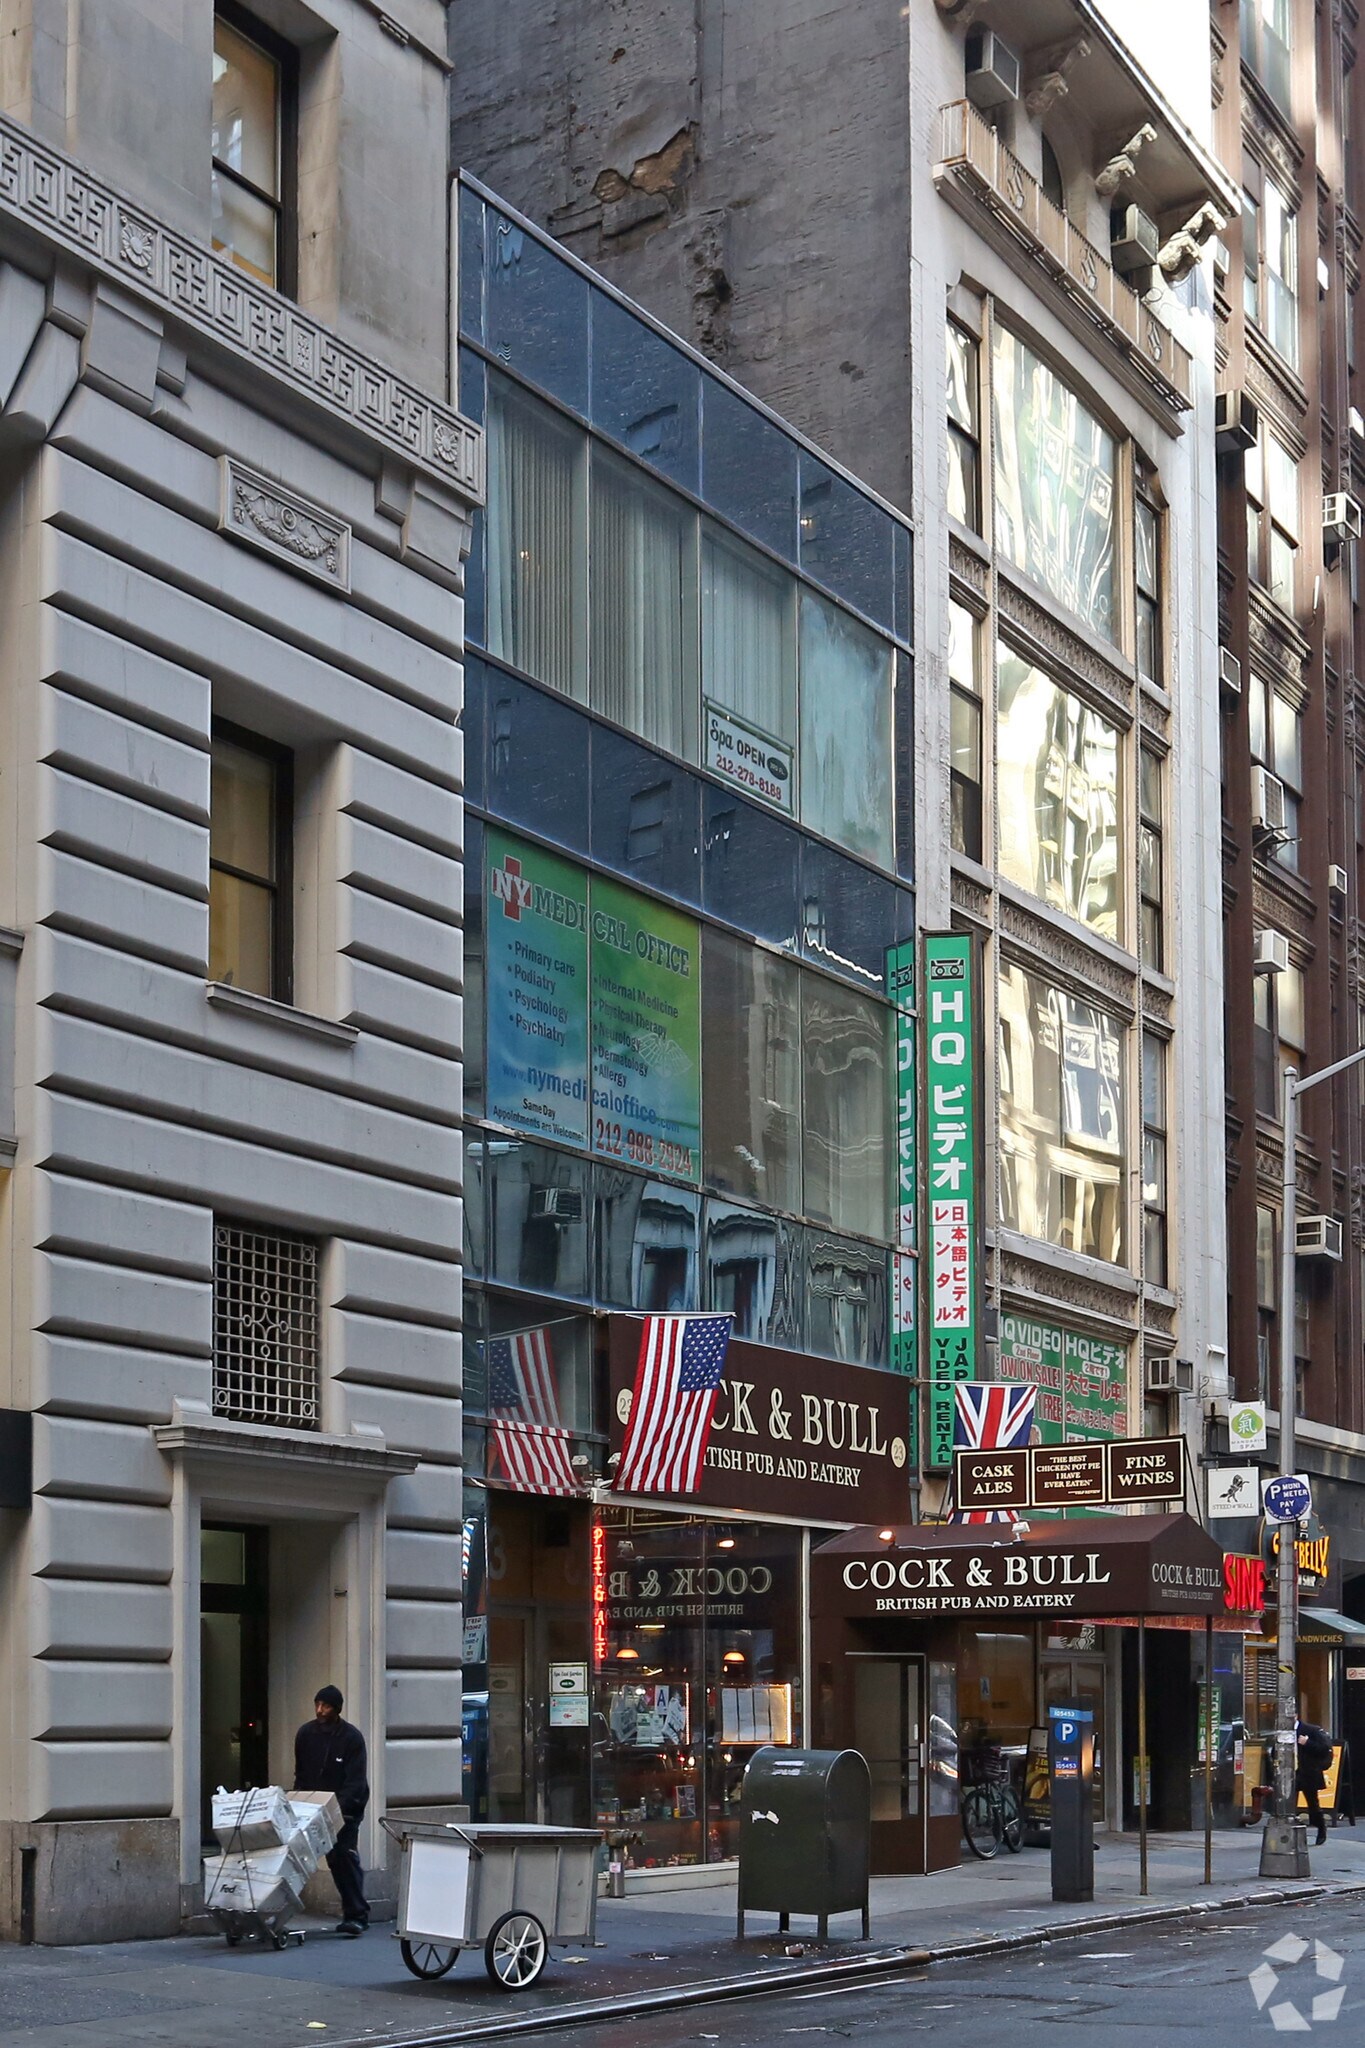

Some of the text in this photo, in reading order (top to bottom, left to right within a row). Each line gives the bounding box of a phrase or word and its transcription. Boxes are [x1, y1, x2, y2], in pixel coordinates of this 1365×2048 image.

[710, 719, 734, 750] Spa
[736, 739, 766, 769] OPEN
[716, 753, 782, 801] 212-278-8188
[493, 867, 691, 979] NY MEDICAL OFFICE
[515, 941, 576, 977] Primary care
[514, 964, 556, 995] Podiatry
[515, 988, 568, 1024] Psychology
[599, 974, 679, 1018] Internal Medicine
[516, 1013, 566, 1047] Psychiatry
[599, 998, 667, 1040] Physical Therapy
[600, 1022, 640, 1053] Neurology
[599, 1045, 648, 1077] Dermatology
[599, 1064, 627, 1088] Allergy
[502, 1064, 680, 1134] www.nymedicaloffice.com
[932, 990, 967, 1190] HQ ビデオ
[493, 1105, 540, 1128] Appointments
[541, 1121, 551, 1131] are
[523, 1098, 556, 1121] Same Day
[596, 1118, 692, 1176] 212-988-2924
[935, 1206, 952, 1321] レンタル
[951, 1205, 967, 1321] 日本語ビデオ
[1017, 1321, 1061, 1353] VIDEO
[1000, 1354, 1018, 1379] OW
[1019, 1358, 1033, 1381] ON
[935, 1337, 951, 1464] VIDEO RENTAL
[768, 1387, 793, 1442] &
[801, 1393, 888, 1456] BULL
[746, 1452, 774, 1476] PUB
[776, 1457, 807, 1480] AND
[810, 1461, 861, 1488] EATERY
[971, 1464, 1014, 1478] CASK
[1036, 1464, 1070, 1472] CHICKEN
[1088, 1462, 1100, 1470] PIE
[1125, 1454, 1166, 1470] FINE
[973, 1481, 1013, 1495] ALES
[1044, 1480, 1064, 1488] EVER
[1117, 1471, 1175, 1487] WINES
[1270, 1484, 1281, 1500] P
[1283, 1489, 1308, 1498] METER
[1280, 1500, 1295, 1508] PAY
[843, 1553, 1111, 1590] COCK & BULL
[1272, 1535, 1330, 1578] BELLY
[1152, 1563, 1222, 1588] COCK & BULL
[876, 1593, 1076, 1611] BRITISH PUB AND EATERY
[1296, 1635, 1343, 1643] ANDWICHES
[656, 1689, 666, 1706] A
[1062, 1723, 1074, 1741] P
